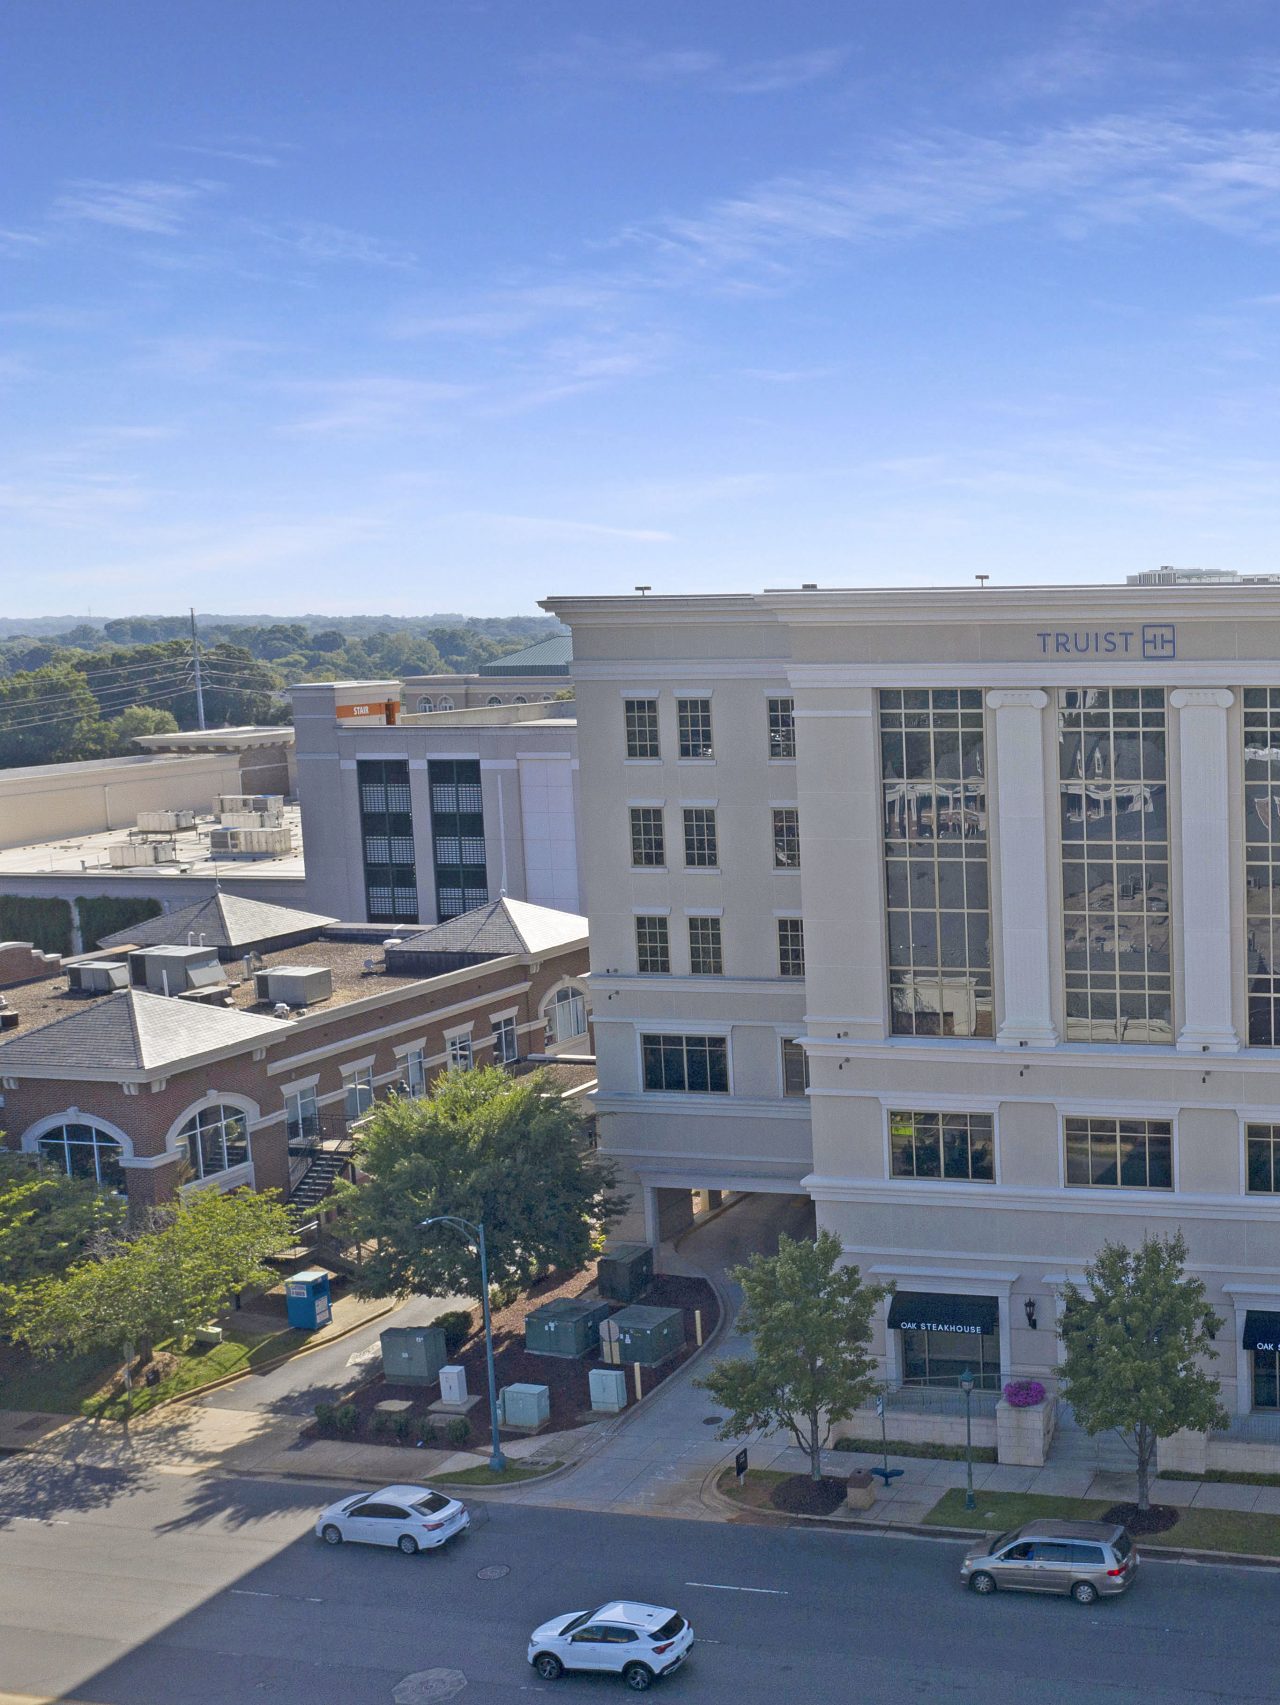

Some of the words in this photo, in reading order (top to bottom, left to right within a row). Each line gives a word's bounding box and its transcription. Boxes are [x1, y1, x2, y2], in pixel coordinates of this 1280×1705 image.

[1037, 632, 1134, 653] TRUIST
[353, 705, 369, 715] STAIR
[900, 1321, 917, 1330] OAK
[920, 1322, 982, 1334] STEAKHOUSE
[1256, 1342, 1274, 1351] OAK
